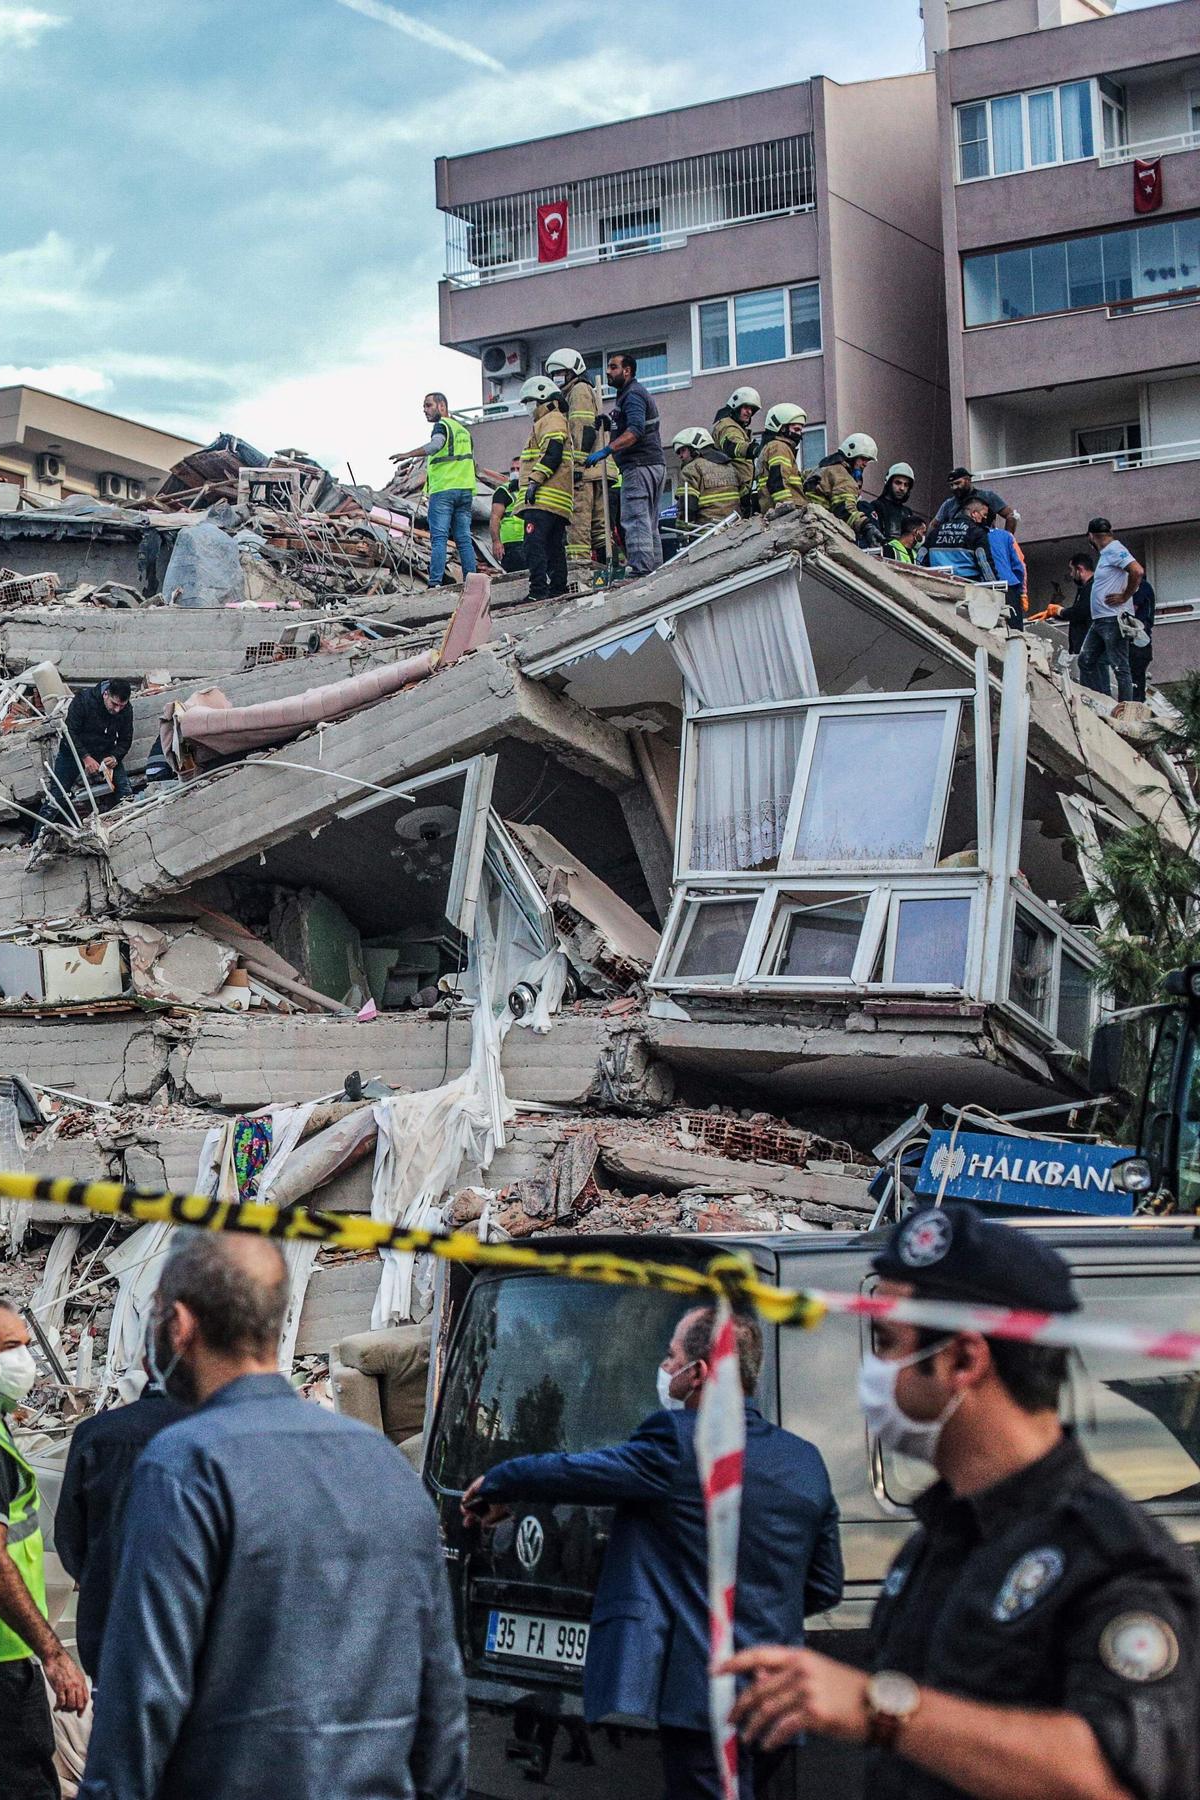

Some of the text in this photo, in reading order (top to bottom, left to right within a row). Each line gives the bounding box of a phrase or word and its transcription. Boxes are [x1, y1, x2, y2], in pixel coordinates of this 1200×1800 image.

[496, 1617, 586, 1661] 35 FA 999
